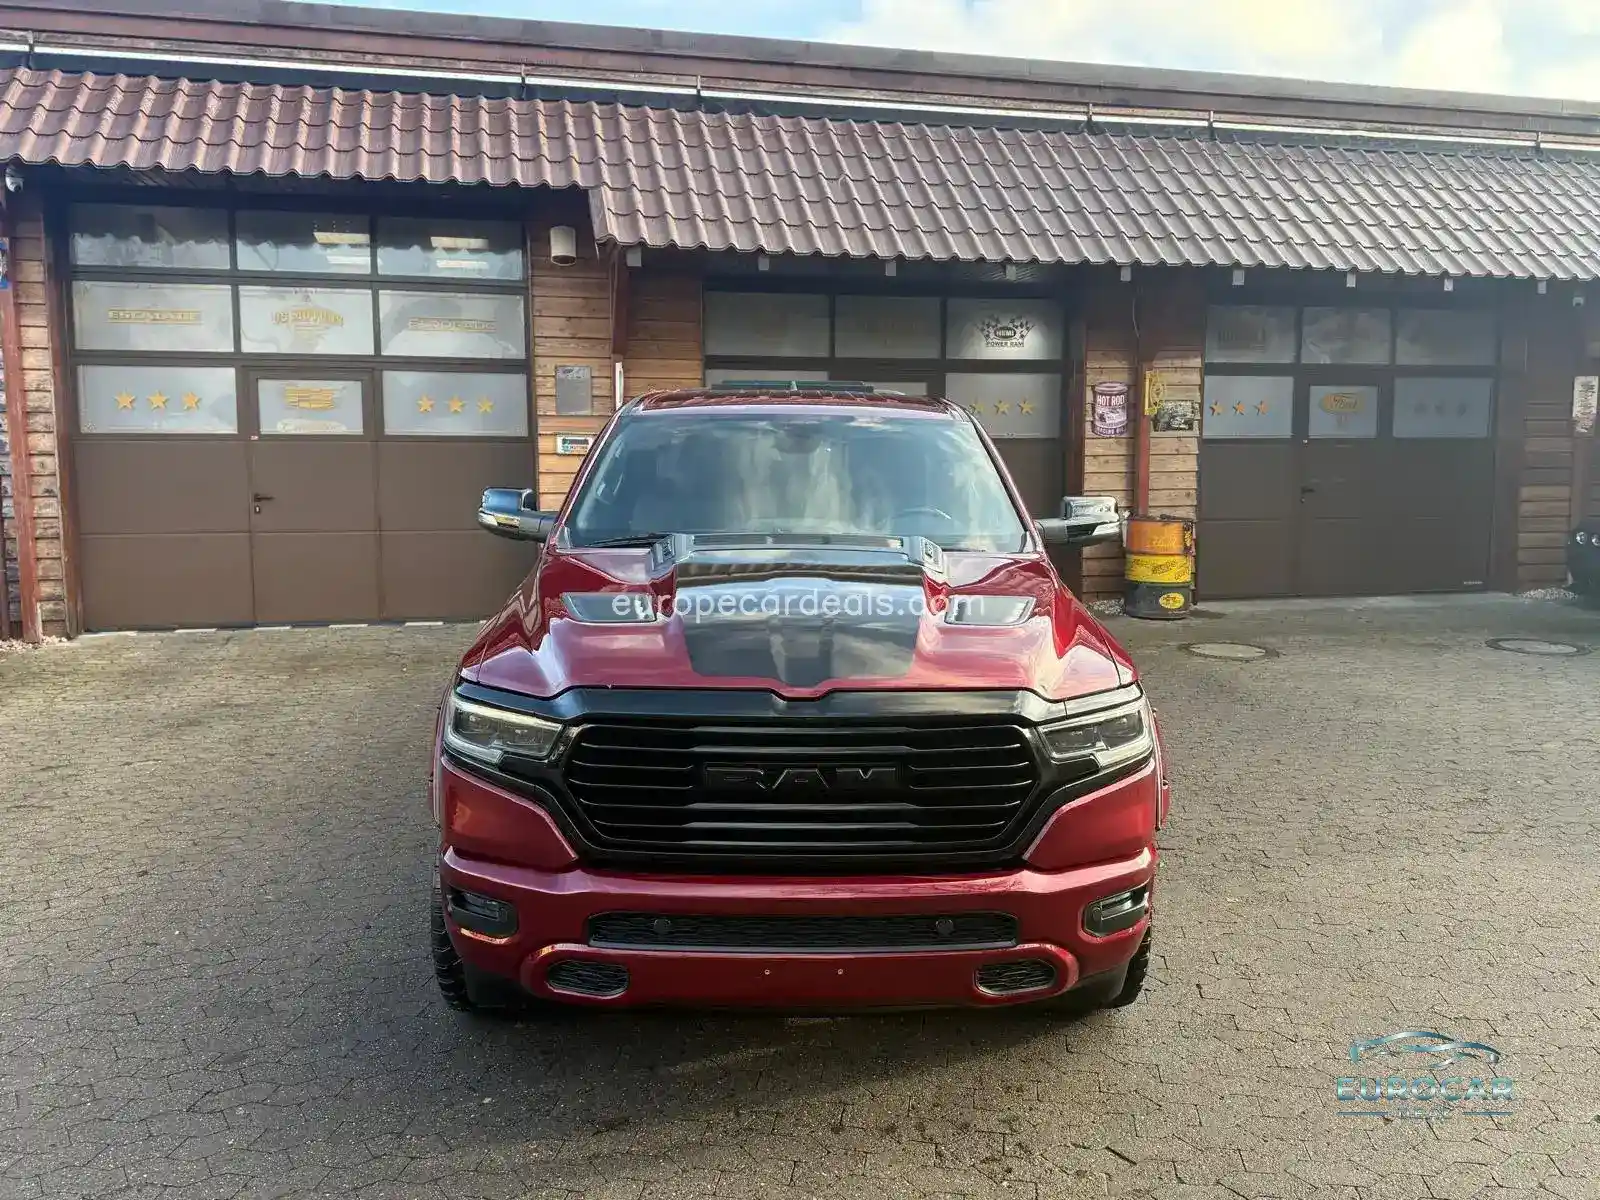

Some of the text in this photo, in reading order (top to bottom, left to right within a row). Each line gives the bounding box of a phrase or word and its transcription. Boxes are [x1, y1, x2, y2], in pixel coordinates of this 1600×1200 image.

[1097, 395, 1125, 406] HOT ROD
[706, 766, 897, 791] RAM
